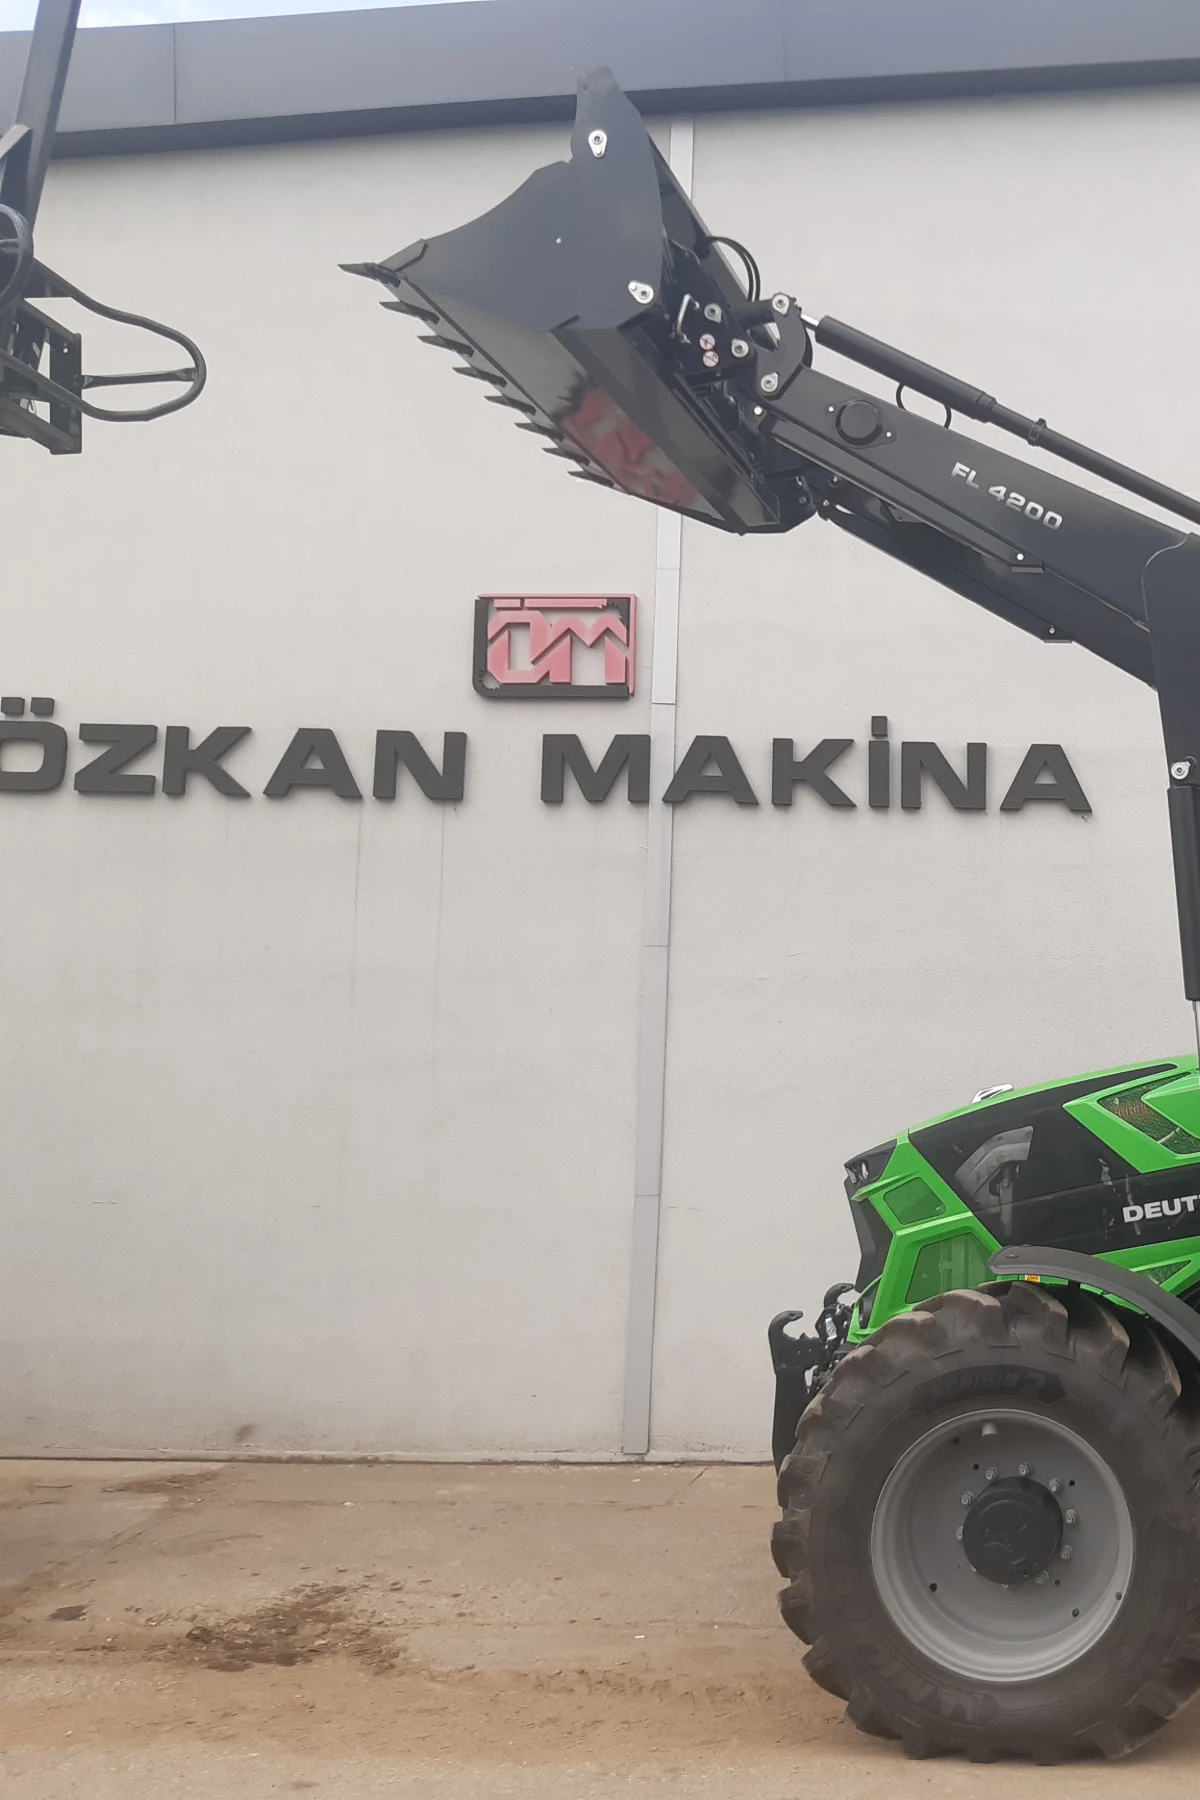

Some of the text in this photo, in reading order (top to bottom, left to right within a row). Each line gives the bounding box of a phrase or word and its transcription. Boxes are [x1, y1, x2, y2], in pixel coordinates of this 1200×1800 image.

[951, 462, 1063, 531] FL 4200
[0, 697, 1093, 812] ÖZKAN MAKİNA
